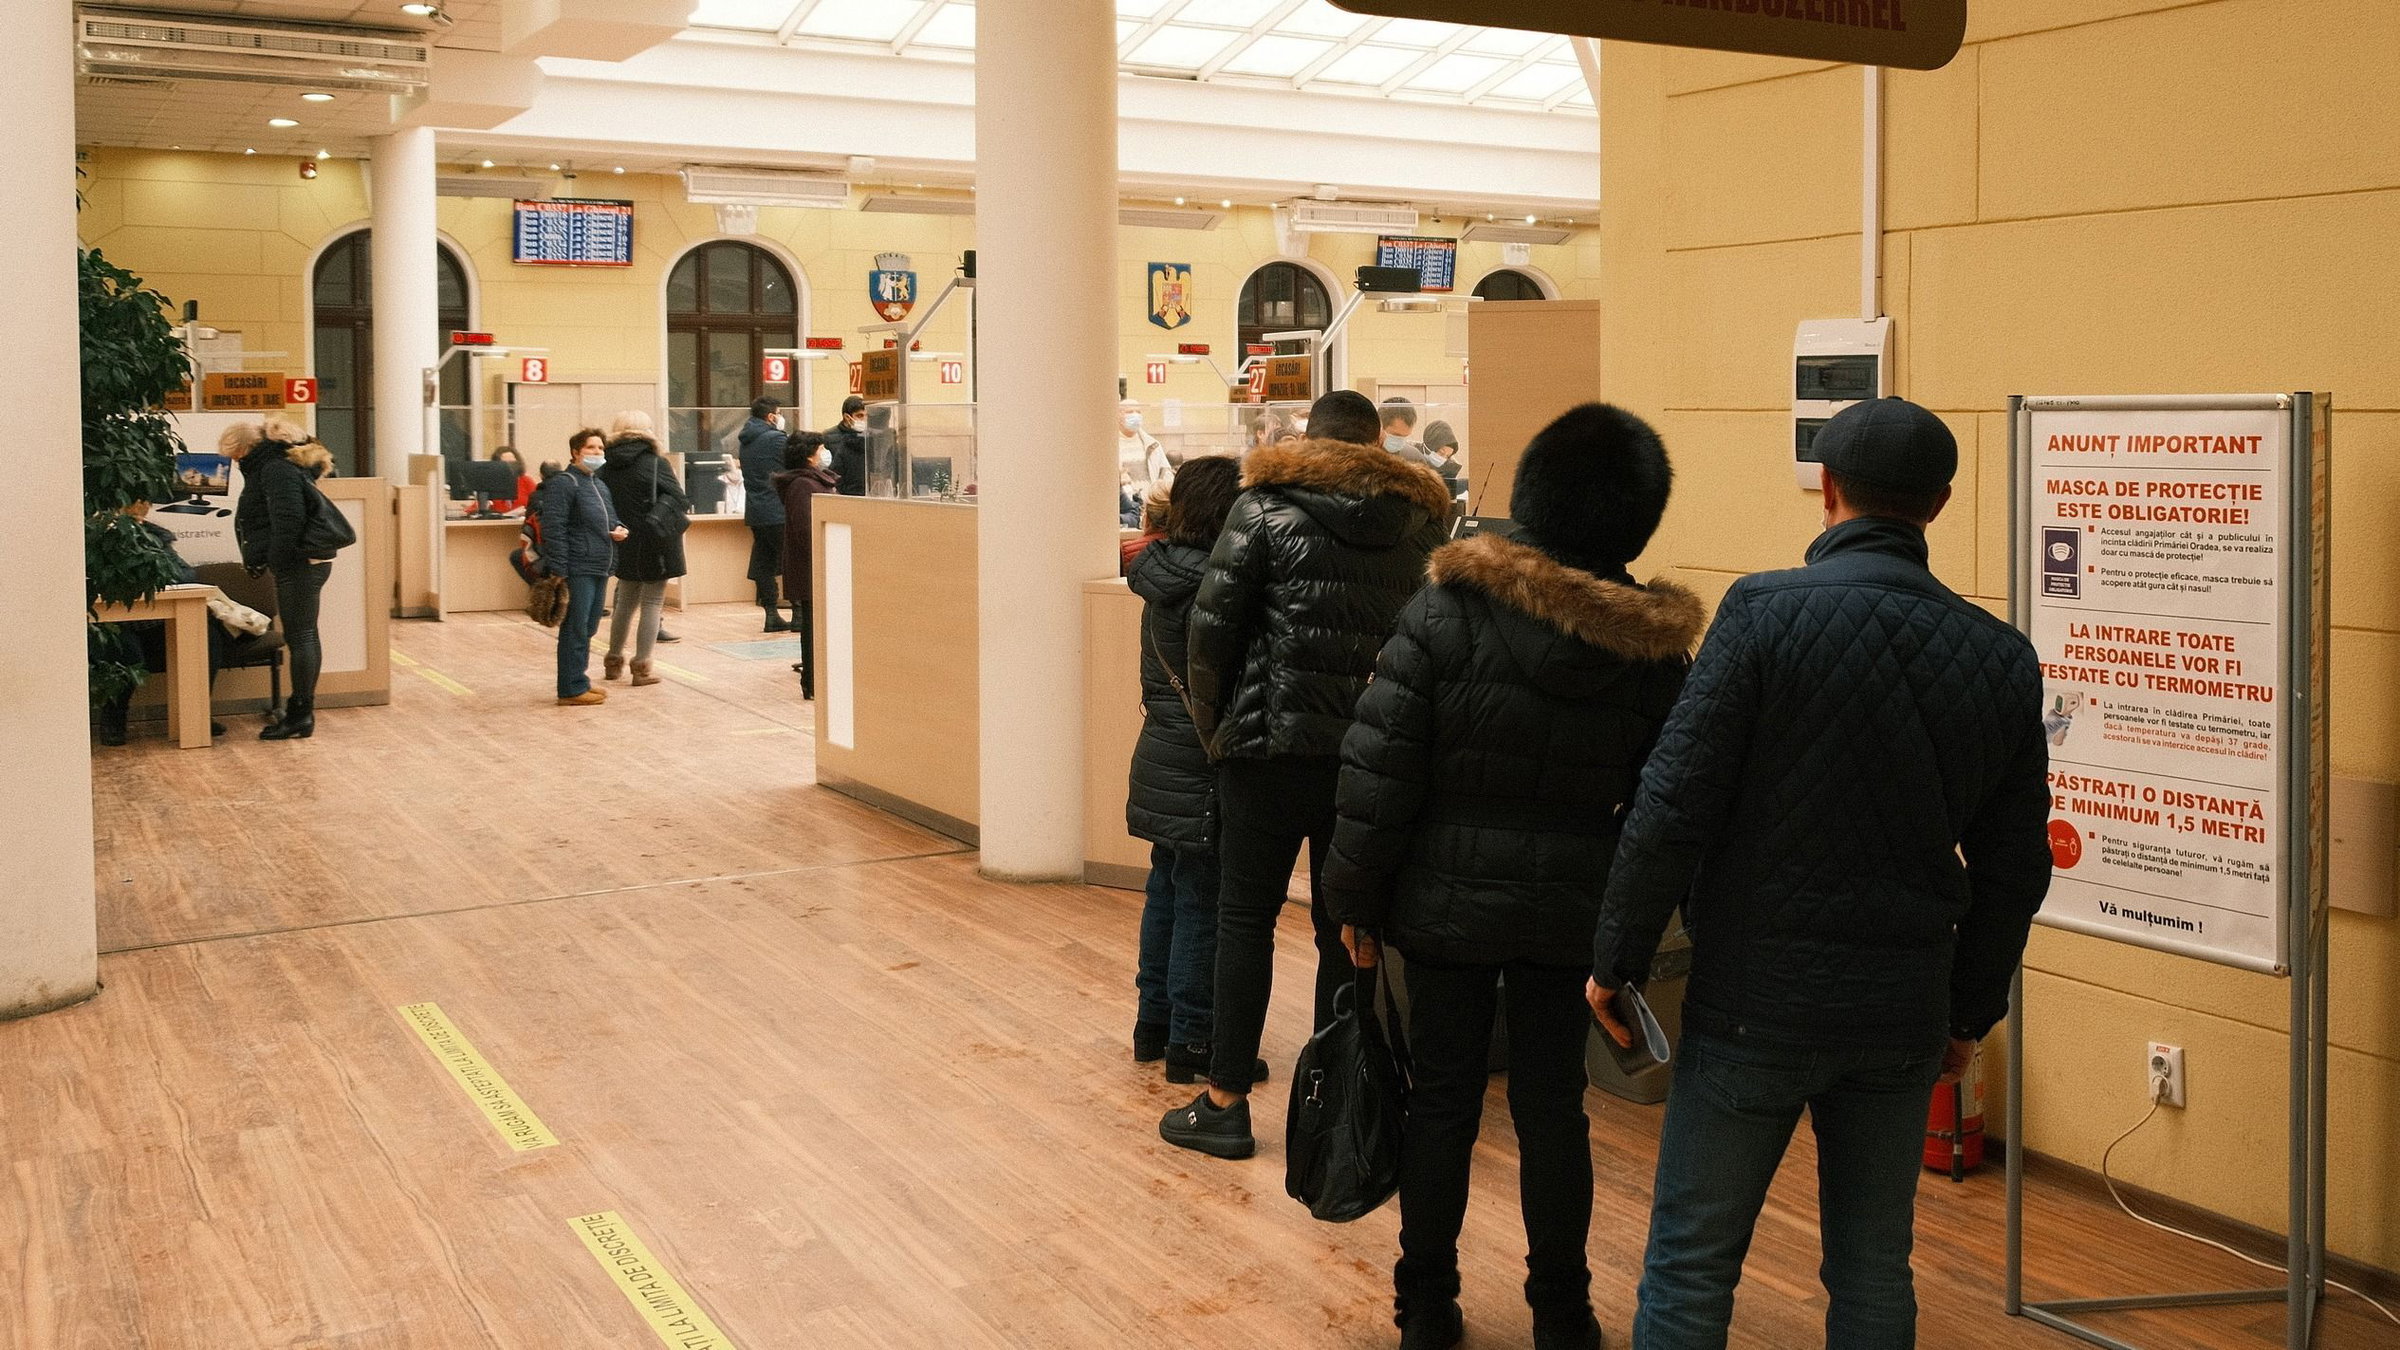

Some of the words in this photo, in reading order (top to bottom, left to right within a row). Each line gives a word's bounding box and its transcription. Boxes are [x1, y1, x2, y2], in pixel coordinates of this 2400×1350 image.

[526, 360, 543, 380] 8
[770, 360, 784, 380] 9
[851, 364, 862, 391] 27
[943, 363, 961, 382] 10
[1149, 364, 1164, 382] 11
[1251, 368, 1266, 393] 27
[293, 380, 310, 401] 5
[2048, 435, 2120, 457] ANUNȚ
[2127, 435, 2262, 454] IMPORTANT
[2047, 479, 2109, 496] MASCA
[2115, 481, 2139, 497] DE
[2146, 482, 2262, 504] PROTECȚIE
[2057, 503, 2101, 519] ESTE
[2108, 504, 2248, 524] OBLIGATORIE!
[2100, 528, 2131, 536] Accesul
[2218, 533, 2260, 542] publicului
[2100, 539, 2126, 547] incinta
[2189, 542, 2221, 552] Oradea,
[2100, 568, 2126, 577] Pentru
[2170, 572, 2200, 582] eficace,
[2231, 575, 2261, 584] trebuie
[2100, 580, 2131, 589] acopere
[2147, 583, 2165, 591] gura
[2187, 584, 2211, 592] nasul!
[2070, 623, 2090, 639] LA
[2095, 625, 2171, 646] INTRARE
[2176, 632, 2234, 652] TOATE
[2064, 644, 2176, 669] PERSOANELE
[2181, 655, 2219, 673] VOR
[2225, 659, 2241, 676] FI
[2040, 663, 2109, 684] TESTATE
[2115, 671, 2138, 688] CU
[2144, 674, 2272, 702] TERMOMETRU
[2103, 701, 2113, 709] La
[2117, 703, 2148, 714] intrarea
[2248, 718, 2270, 728] toate
[2103, 713, 2144, 724] persoanele
[2168, 719, 2194, 730] testate
[2208, 724, 2257, 739] termometru,
[2260, 730, 2271, 739] iar
[2103, 734, 2135, 744] acestora
[2162, 740, 2195, 751] interzice
[2196, 746, 2226, 755] accesul
[2126, 725, 2176, 738] temperatura
[2228, 737, 2238, 746] 37
[2243, 740, 2270, 751] grade,
[2046, 772, 2135, 802] PĂSTRAȚI
[2142, 788, 2156, 803] O
[2163, 791, 2263, 822] DISTANȚĂ
[2072, 798, 2159, 826] MINIMUM
[2167, 813, 2194, 833] 1,5
[2202, 819, 2264, 843] METRI
[2102, 835, 2128, 846] Pentru
[2175, 847, 2207, 861] tuturor,
[2102, 856, 2111, 865] de
[2112, 859, 2142, 870] celelalte
[2143, 865, 2182, 877] persoane!
[2168, 858, 2178, 867] de
[2179, 861, 2218, 874] minimum
[2220, 866, 2231, 877] 1,5
[2231, 870, 2252, 879] metri
[2099, 901, 2117, 917] Vă
[2122, 909, 2193, 931] mulțumim
[2198, 922, 2202, 932] !
[580, 1214, 639, 1266] DISCREȚIE
[622, 1265, 653, 1282] DE
[638, 1281, 684, 1318] LIMITA
[668, 1317, 699, 1335] LA
